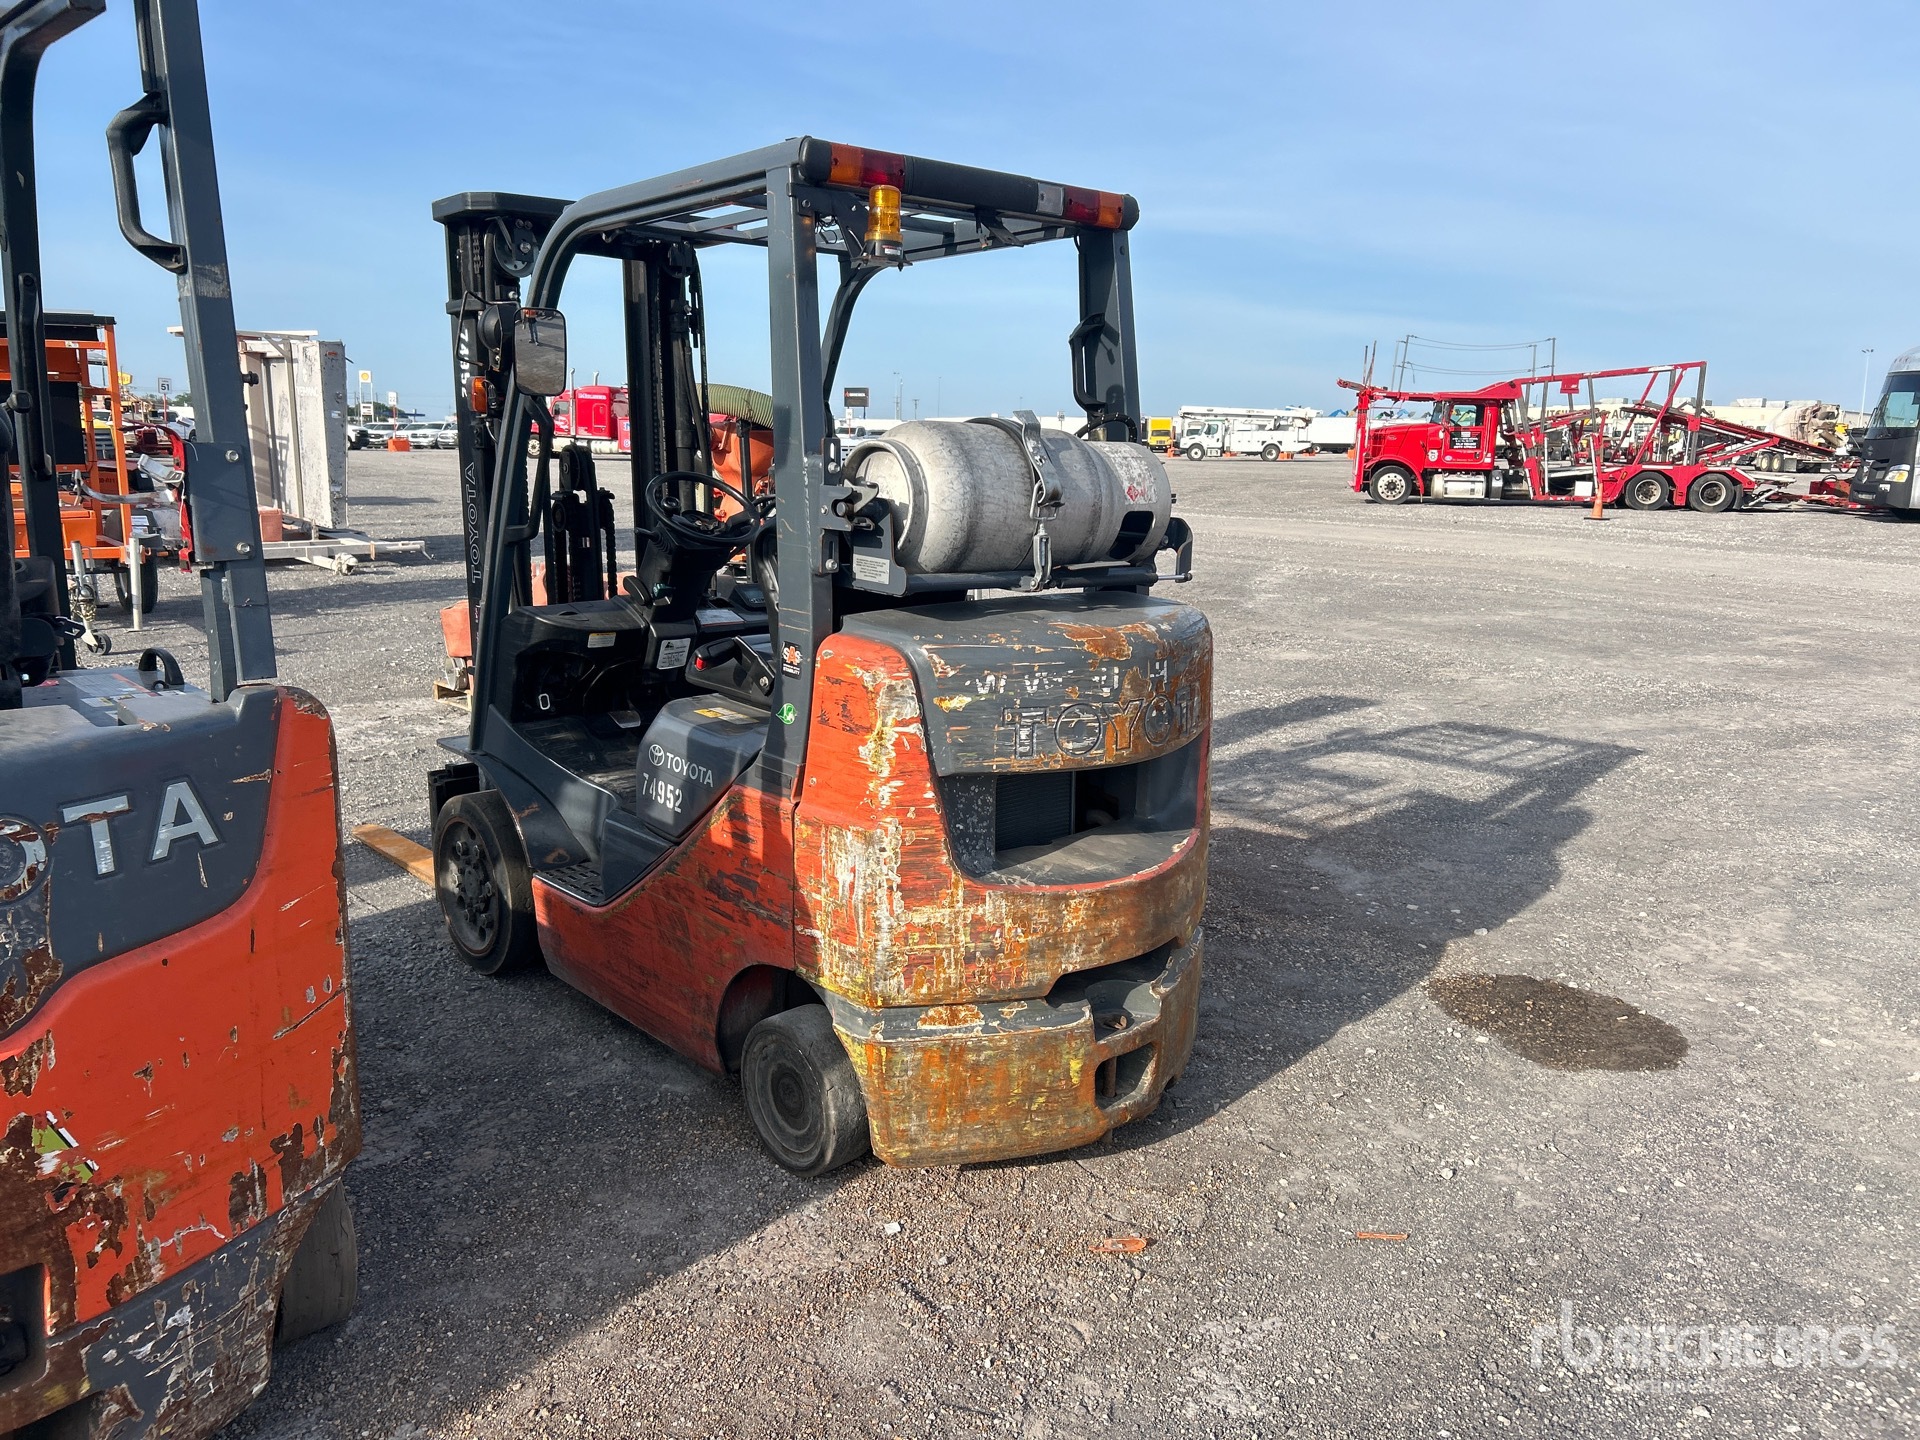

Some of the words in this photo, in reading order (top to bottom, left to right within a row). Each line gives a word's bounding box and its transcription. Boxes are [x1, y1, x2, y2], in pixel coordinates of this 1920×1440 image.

[161, 383, 170, 391] 51
[465, 461, 482, 584] TOYOTA
[666, 752, 713, 788] TOYOTA
[642, 772, 683, 813] 74952
